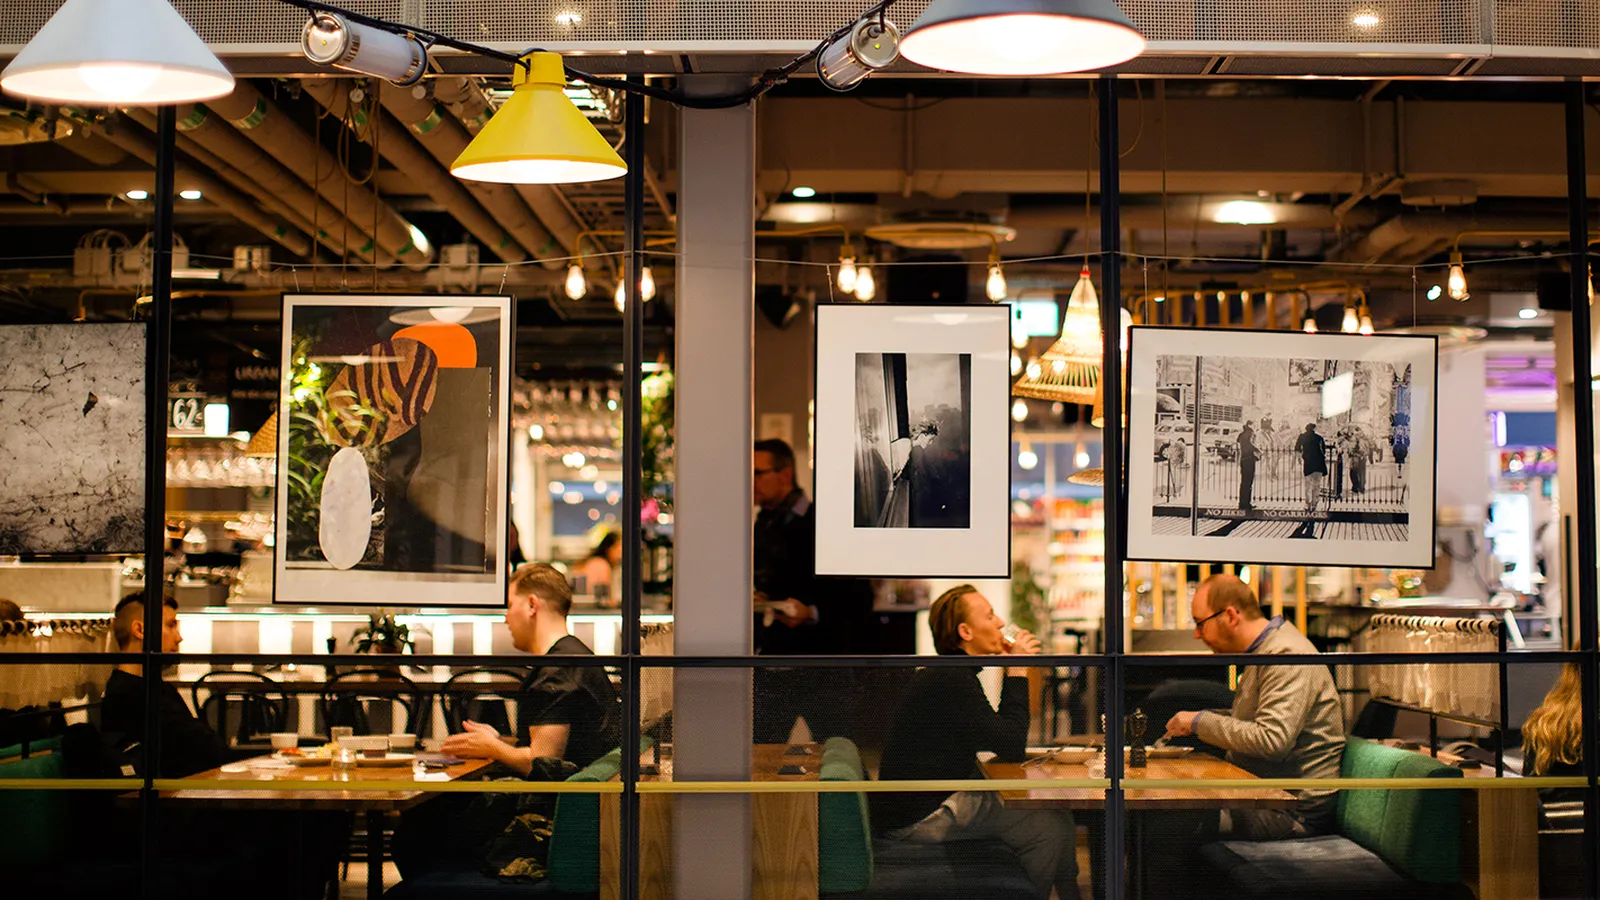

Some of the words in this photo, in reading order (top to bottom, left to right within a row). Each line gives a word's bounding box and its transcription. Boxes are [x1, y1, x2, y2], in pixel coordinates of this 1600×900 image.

[173, 397, 200, 431] 62
[1205, 508, 1221, 516] NO
[1221, 509, 1246, 517] BIKES
[1263, 510, 1277, 518] NO
[1278, 510, 1329, 519] CARRIAGES
